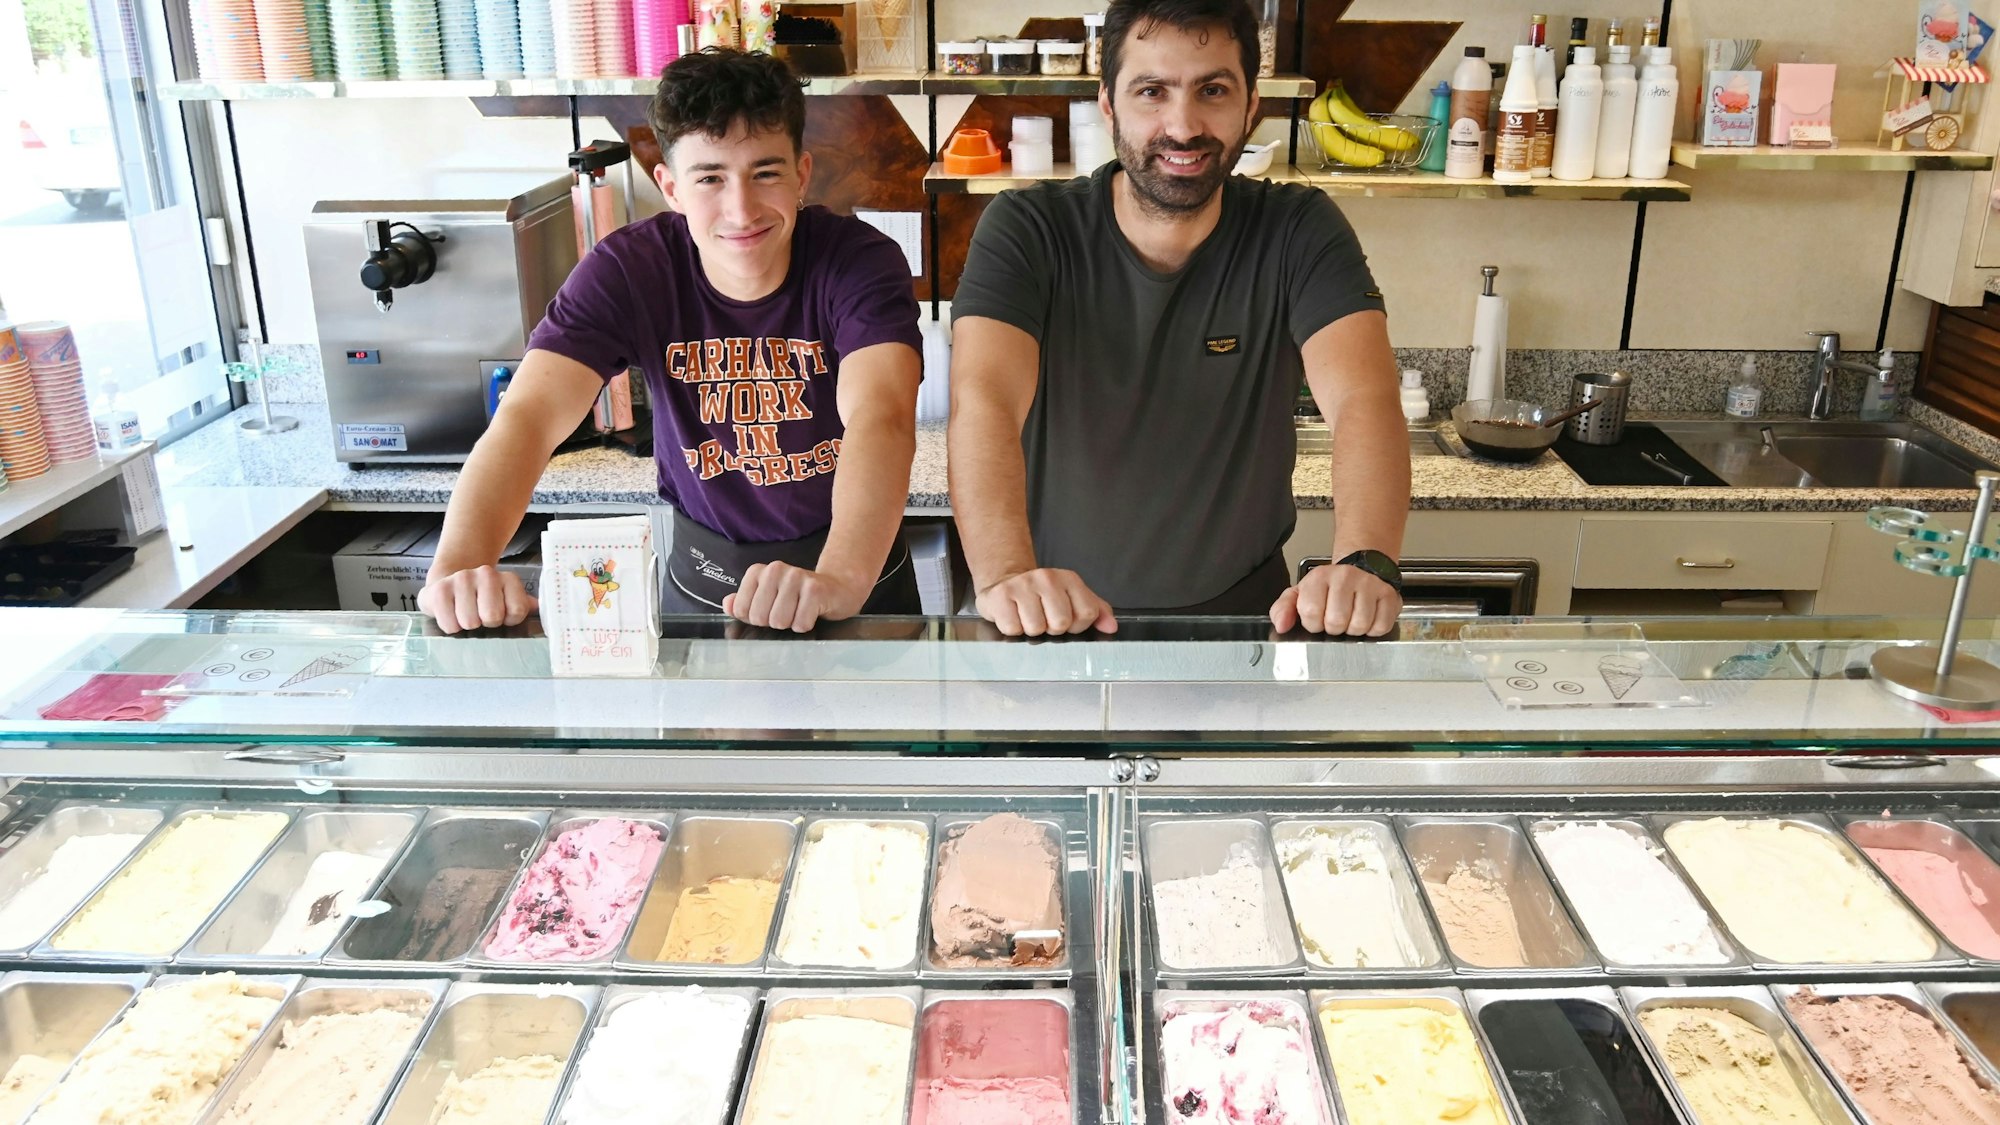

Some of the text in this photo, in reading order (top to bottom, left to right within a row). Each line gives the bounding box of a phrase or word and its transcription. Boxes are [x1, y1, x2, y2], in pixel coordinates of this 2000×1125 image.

[666, 337, 828, 383] CARHARTT
[698, 380, 813, 424] WORK
[733, 424, 782, 457] IN
[581, 647, 605, 657] AUF
[594, 633, 618, 644] LUST
